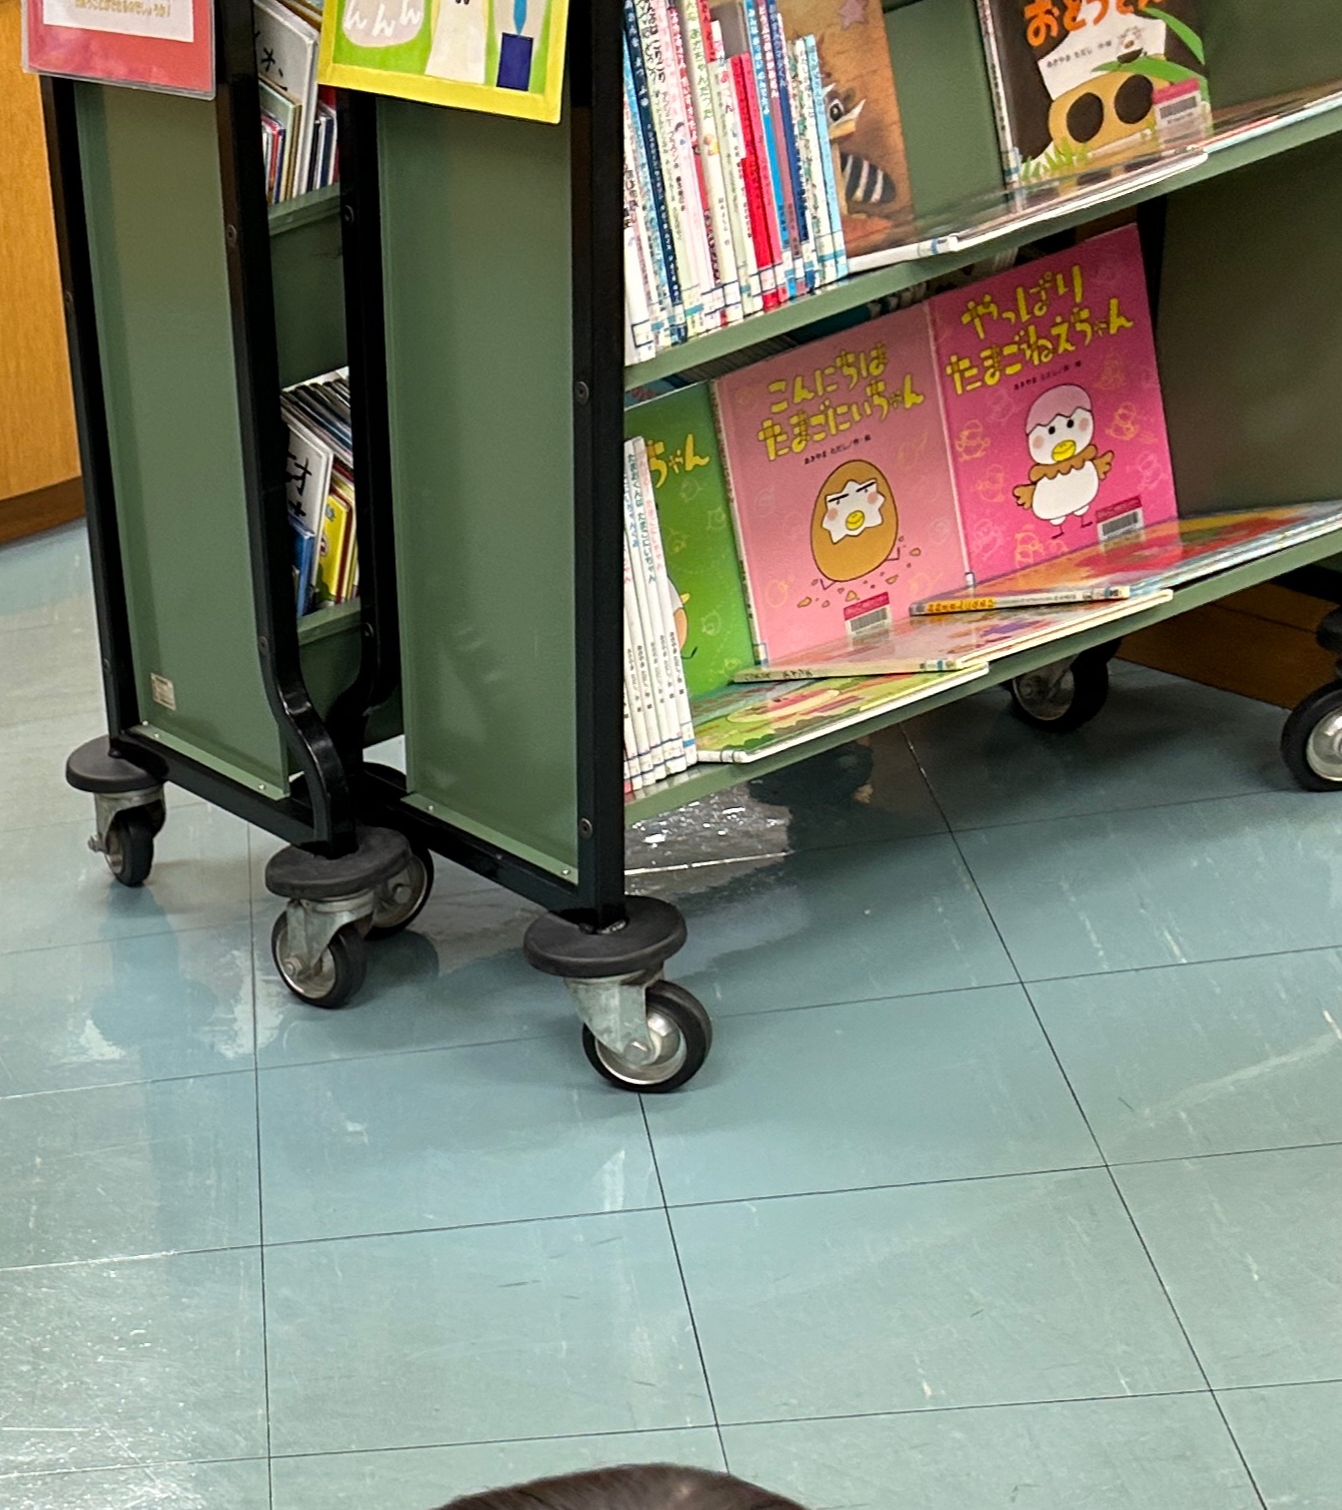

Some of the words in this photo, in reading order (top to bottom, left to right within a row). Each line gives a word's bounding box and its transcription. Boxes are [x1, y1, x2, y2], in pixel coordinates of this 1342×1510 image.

[961, 261, 1085, 342] やっぱり
[767, 340, 888, 413] こんにちは
[945, 296, 1134, 398] たまごねえちゃん
[757, 378, 925, 463] たまごにいちゃん
